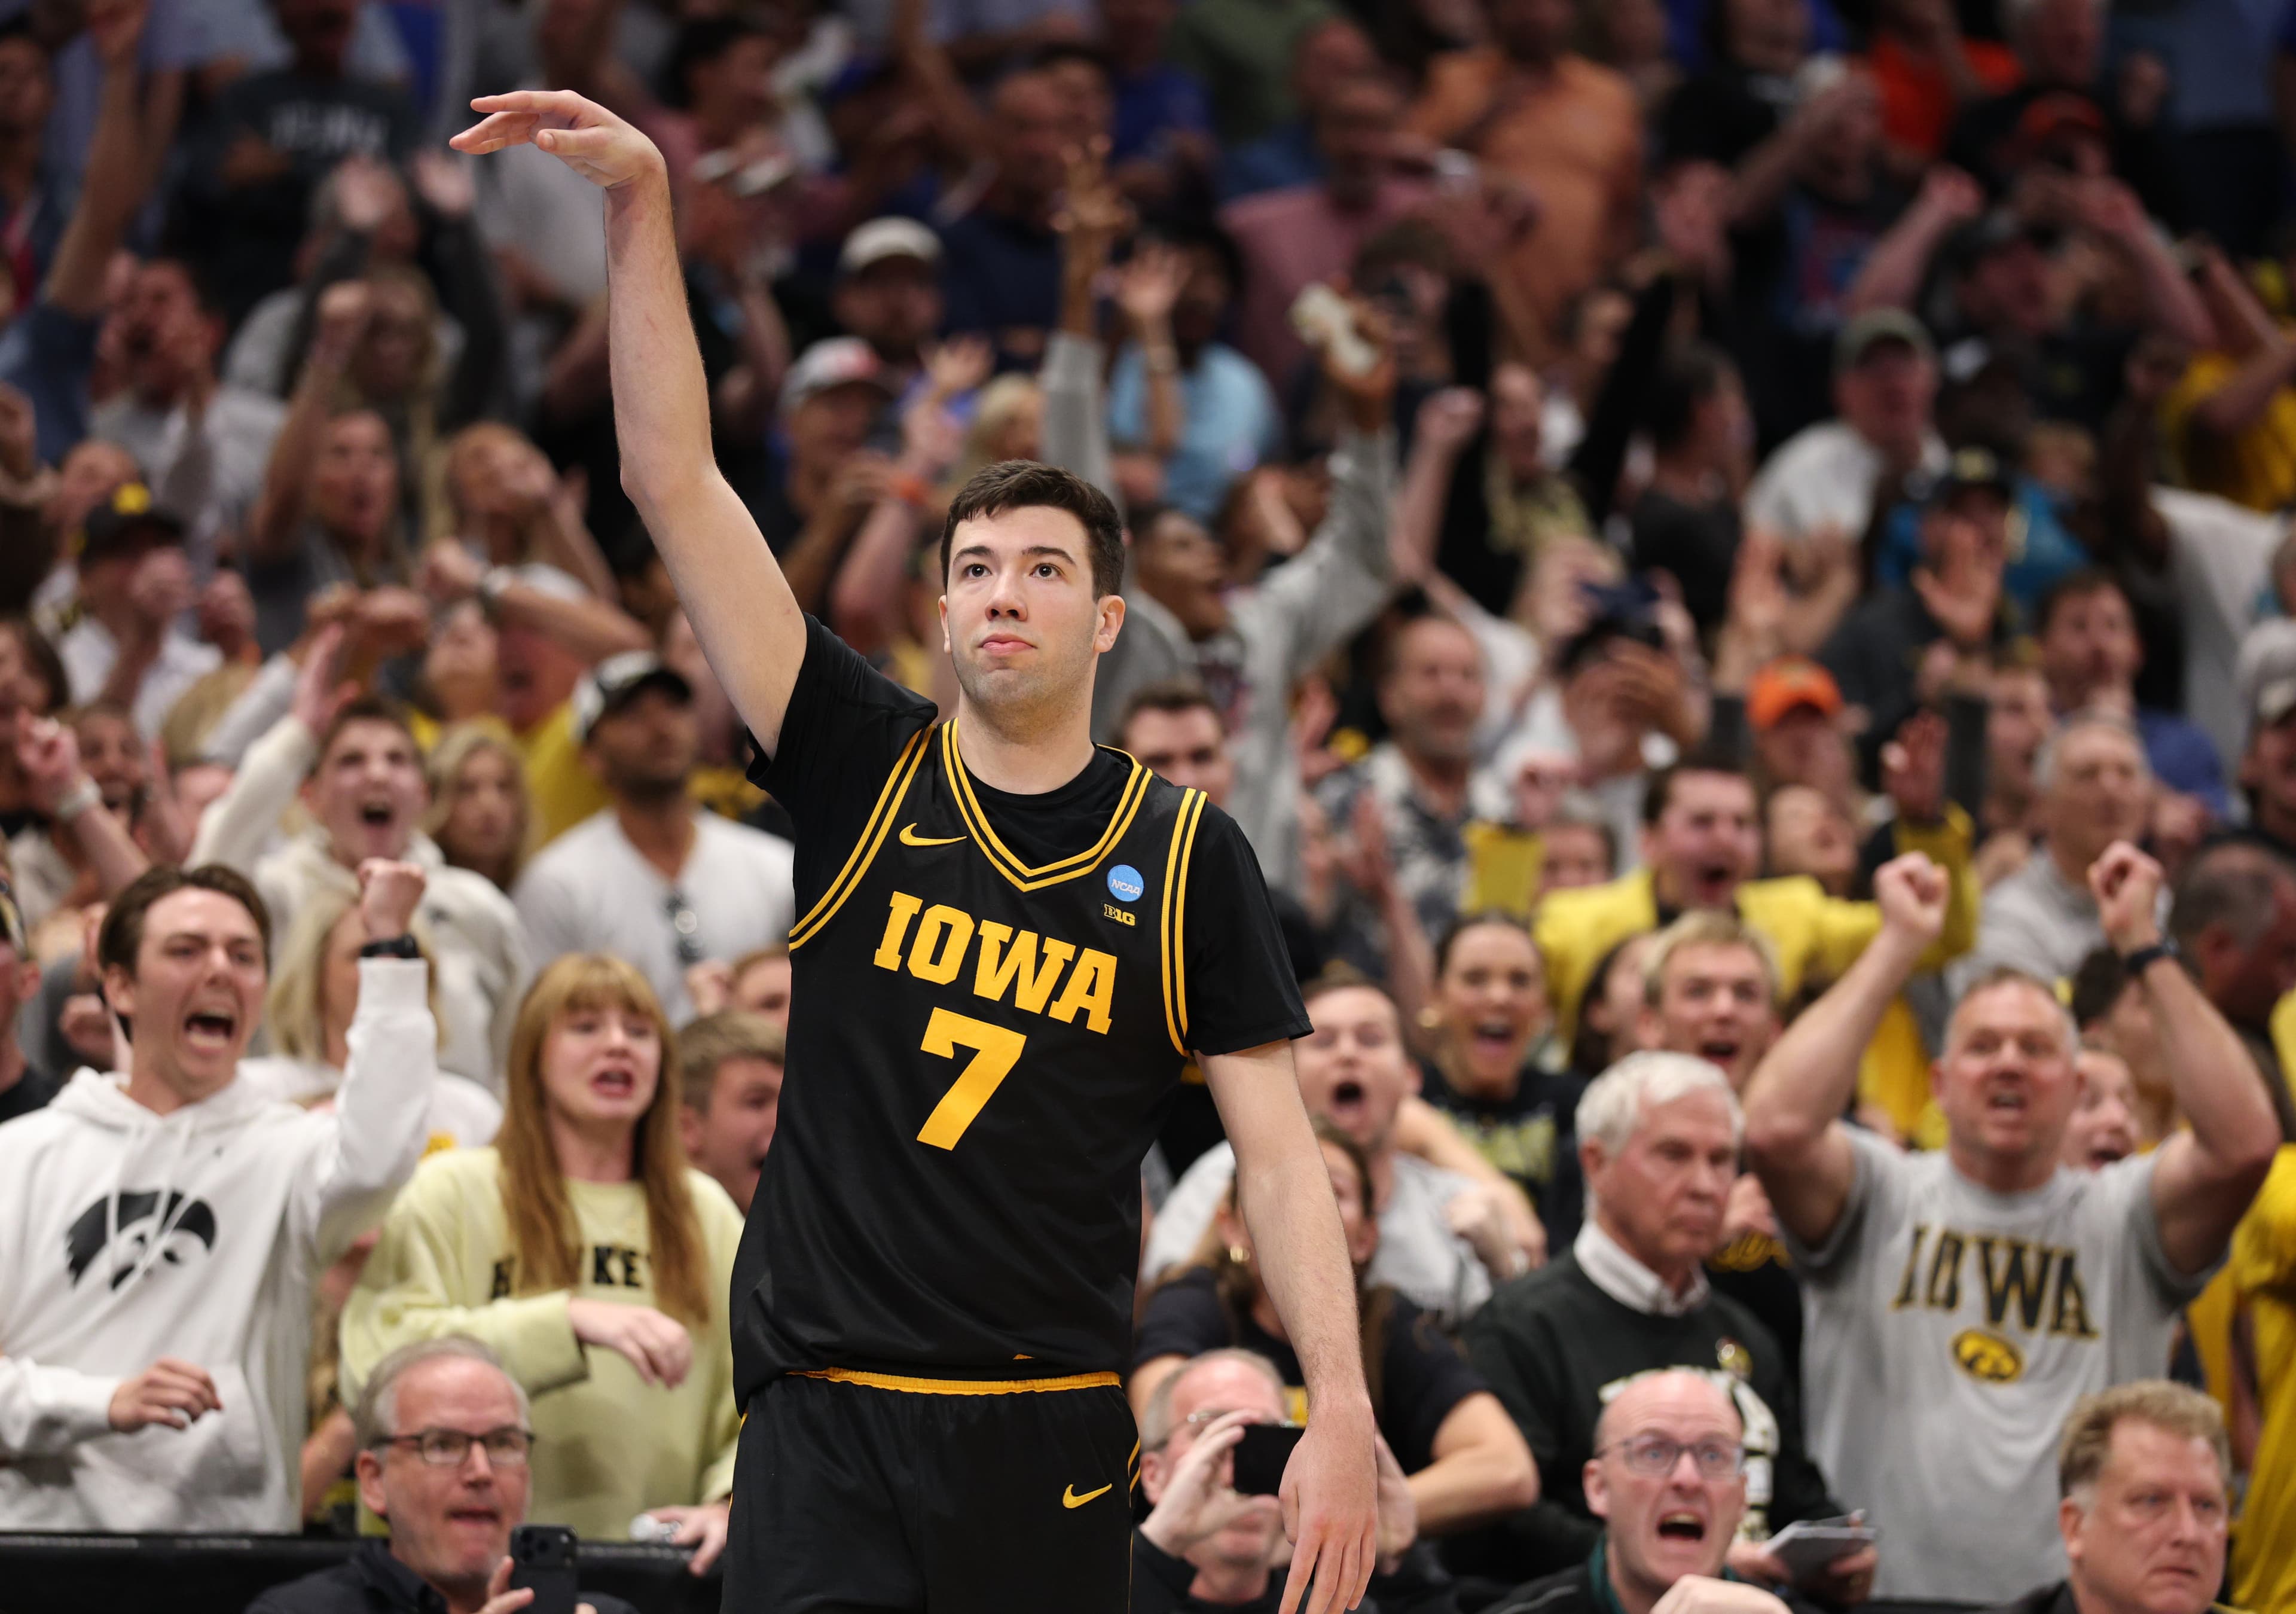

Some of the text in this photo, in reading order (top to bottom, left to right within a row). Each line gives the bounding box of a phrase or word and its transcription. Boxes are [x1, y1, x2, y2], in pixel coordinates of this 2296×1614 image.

[1111, 878, 1141, 896] NCAA
[874, 891, 1117, 1035] IOWA
[916, 1007, 1027, 1151] 7
[1889, 1224, 2100, 1340] IOWA
